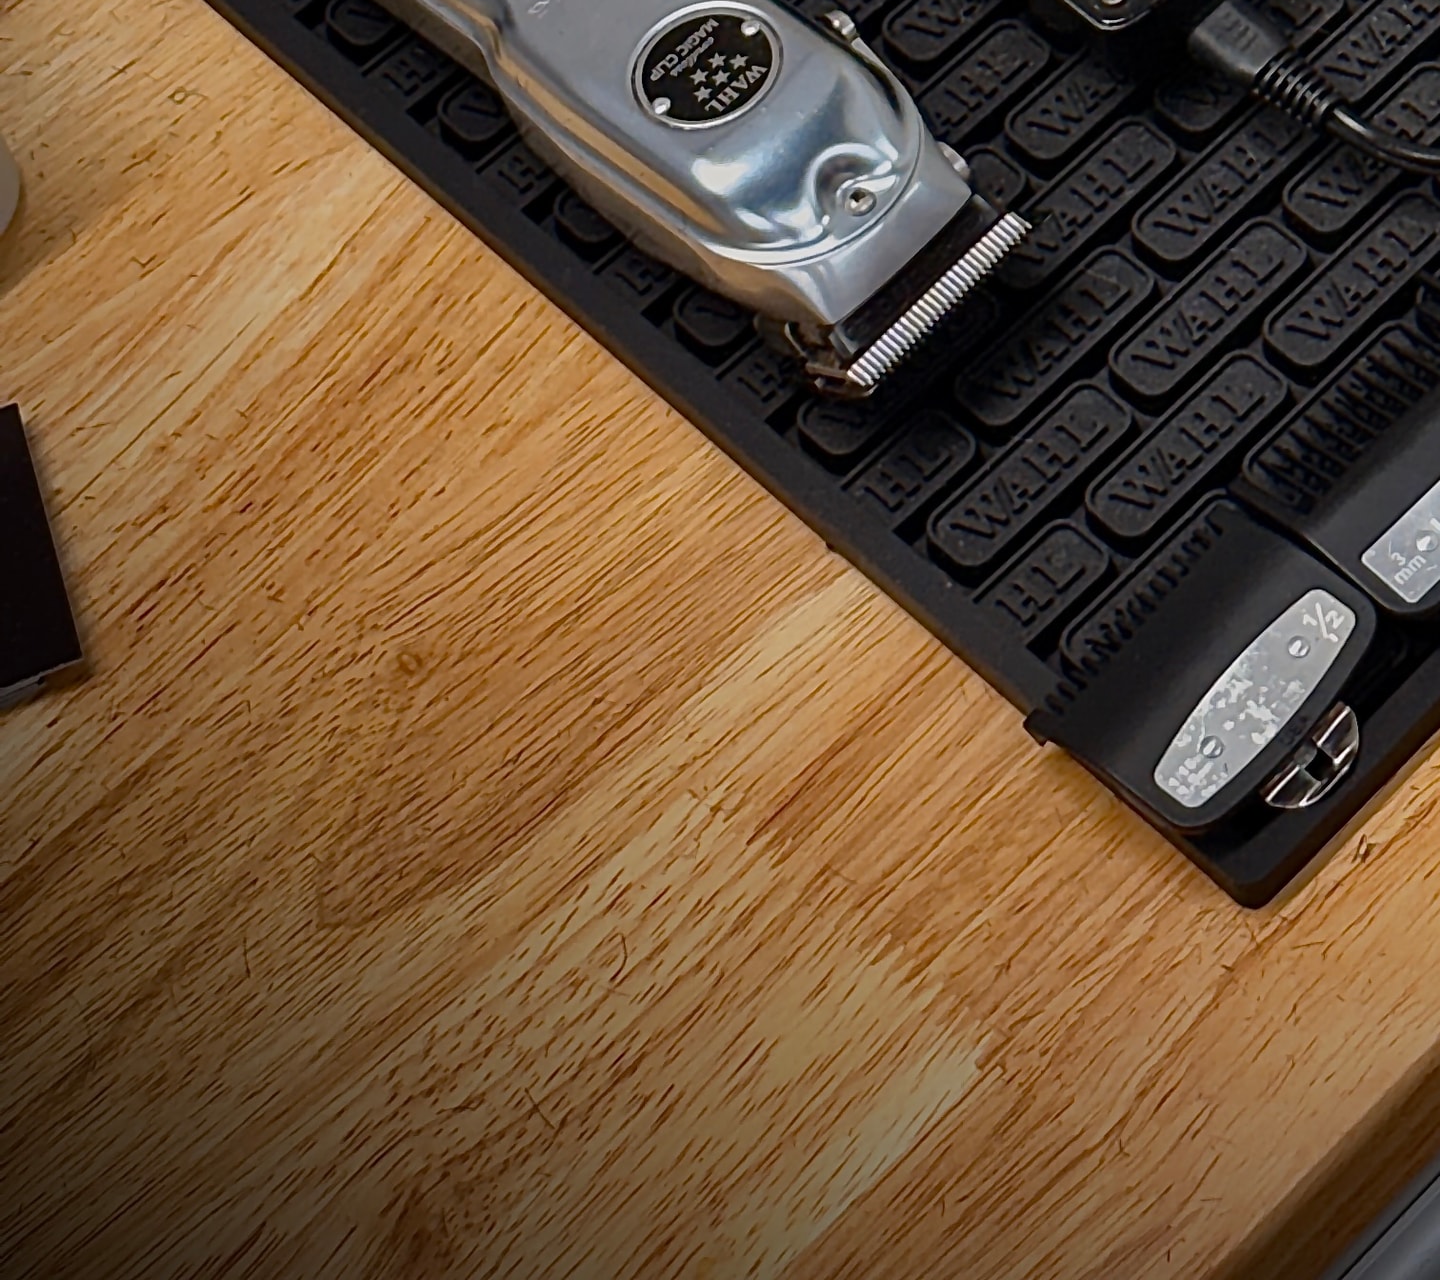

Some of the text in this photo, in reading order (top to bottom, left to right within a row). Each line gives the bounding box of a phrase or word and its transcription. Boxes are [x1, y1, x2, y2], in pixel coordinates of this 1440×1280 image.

[675, 17, 721, 57] MAGIC
[704, 65, 768, 112] WAHL
[1151, 109, 1309, 248] WAHL
[974, 264, 1136, 409] WAHL
[1128, 238, 1289, 382] WAHL
[862, 425, 957, 510] HL
[947, 398, 1113, 548] WAHL
[1104, 371, 1269, 521] WAHL
[992, 537, 1089, 625] HL
[1393, 553, 1427, 586] mm
